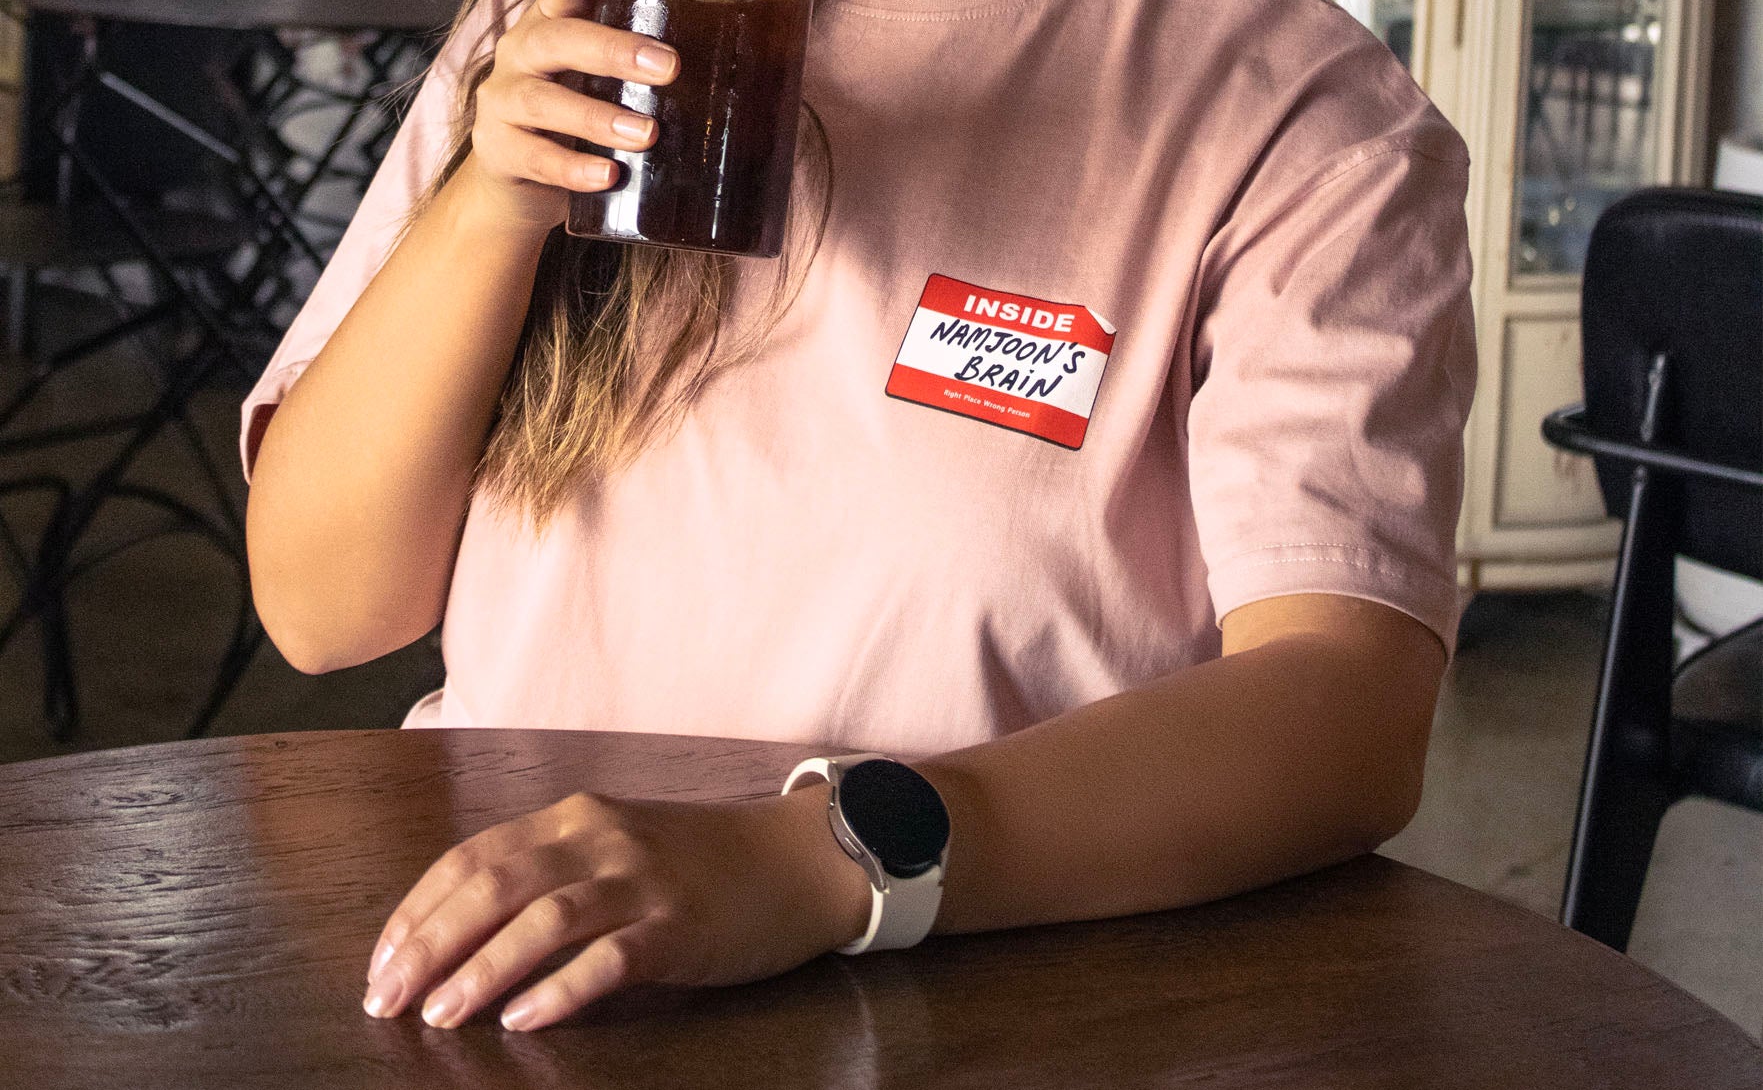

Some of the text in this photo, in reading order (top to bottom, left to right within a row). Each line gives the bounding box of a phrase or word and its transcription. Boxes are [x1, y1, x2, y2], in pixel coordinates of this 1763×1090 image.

[964, 294, 1075, 333] INSIDE
[930, 319, 1085, 374] NAMJOON'S
[943, 389, 1031, 418] Right Place Wrong Person
